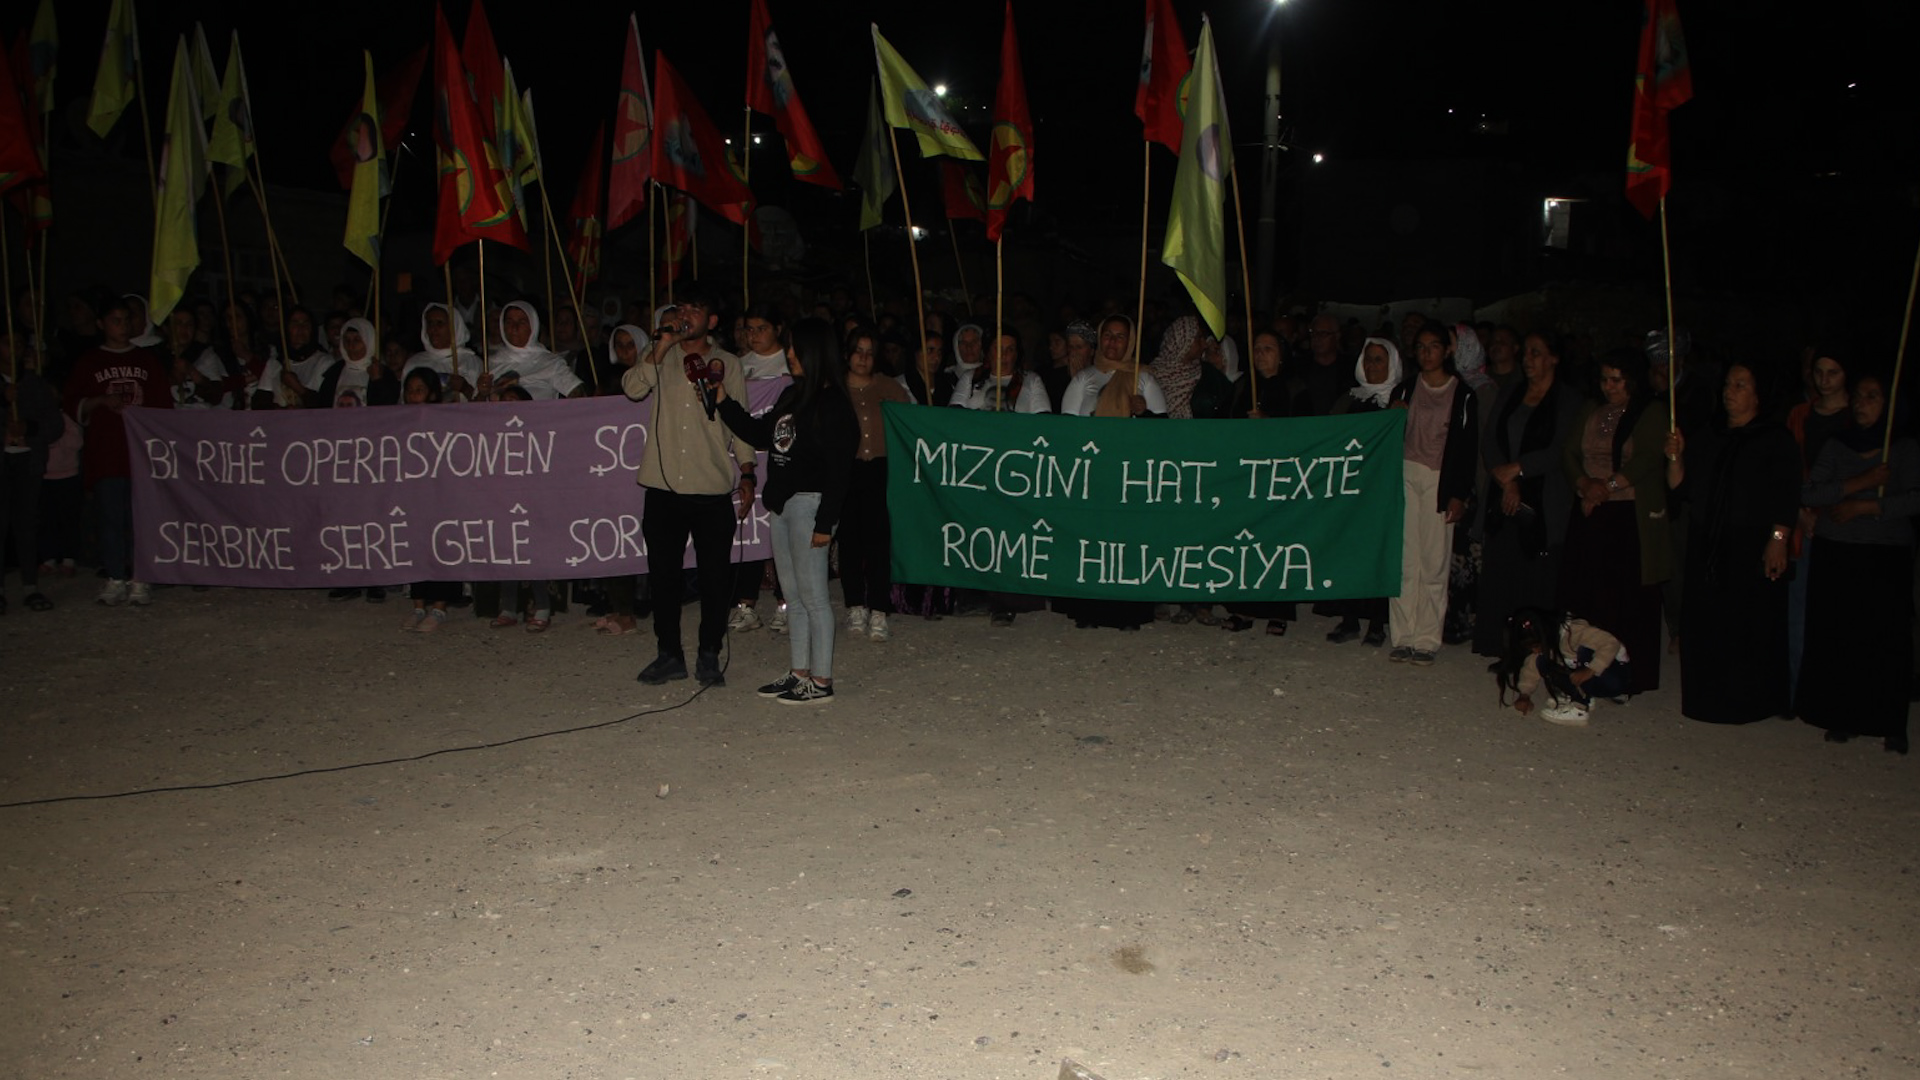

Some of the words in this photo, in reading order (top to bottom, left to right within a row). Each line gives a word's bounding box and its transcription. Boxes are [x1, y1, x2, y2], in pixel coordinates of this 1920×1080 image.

[95, 366, 148, 383] HARVARD
[146, 438, 179, 480] BI
[197, 426, 268, 485] RIHÊ
[282, 415, 557, 486] OPERASYONÊN
[913, 436, 1101, 500] MIZGÎNÎ
[1120, 459, 1221, 510] HAT,
[1239, 438, 1364, 501] TEXTÊ
[155, 521, 295, 571] SERBIXE
[320, 506, 413, 574] ŞERÊ
[432, 503, 532, 566] GELÊ
[942, 519, 1054, 581] ROMÊ
[1077, 529, 1333, 595] HILWEŞÎYA.
